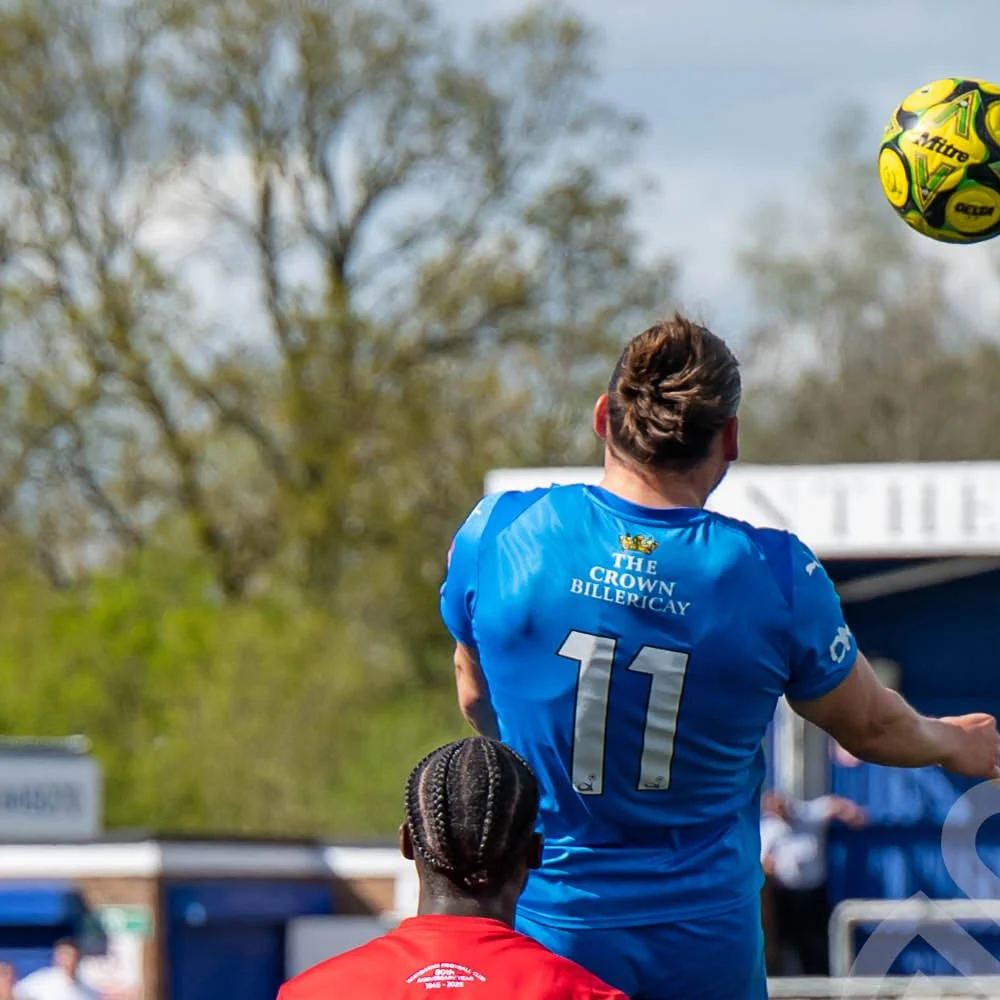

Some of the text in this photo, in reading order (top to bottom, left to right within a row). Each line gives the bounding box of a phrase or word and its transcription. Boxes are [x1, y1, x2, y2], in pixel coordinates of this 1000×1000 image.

[612, 552, 658, 576] THE
[570, 578, 691, 616] BILLERICAY
[588, 566, 676, 597] CROWN
[556, 629, 690, 795] 11
